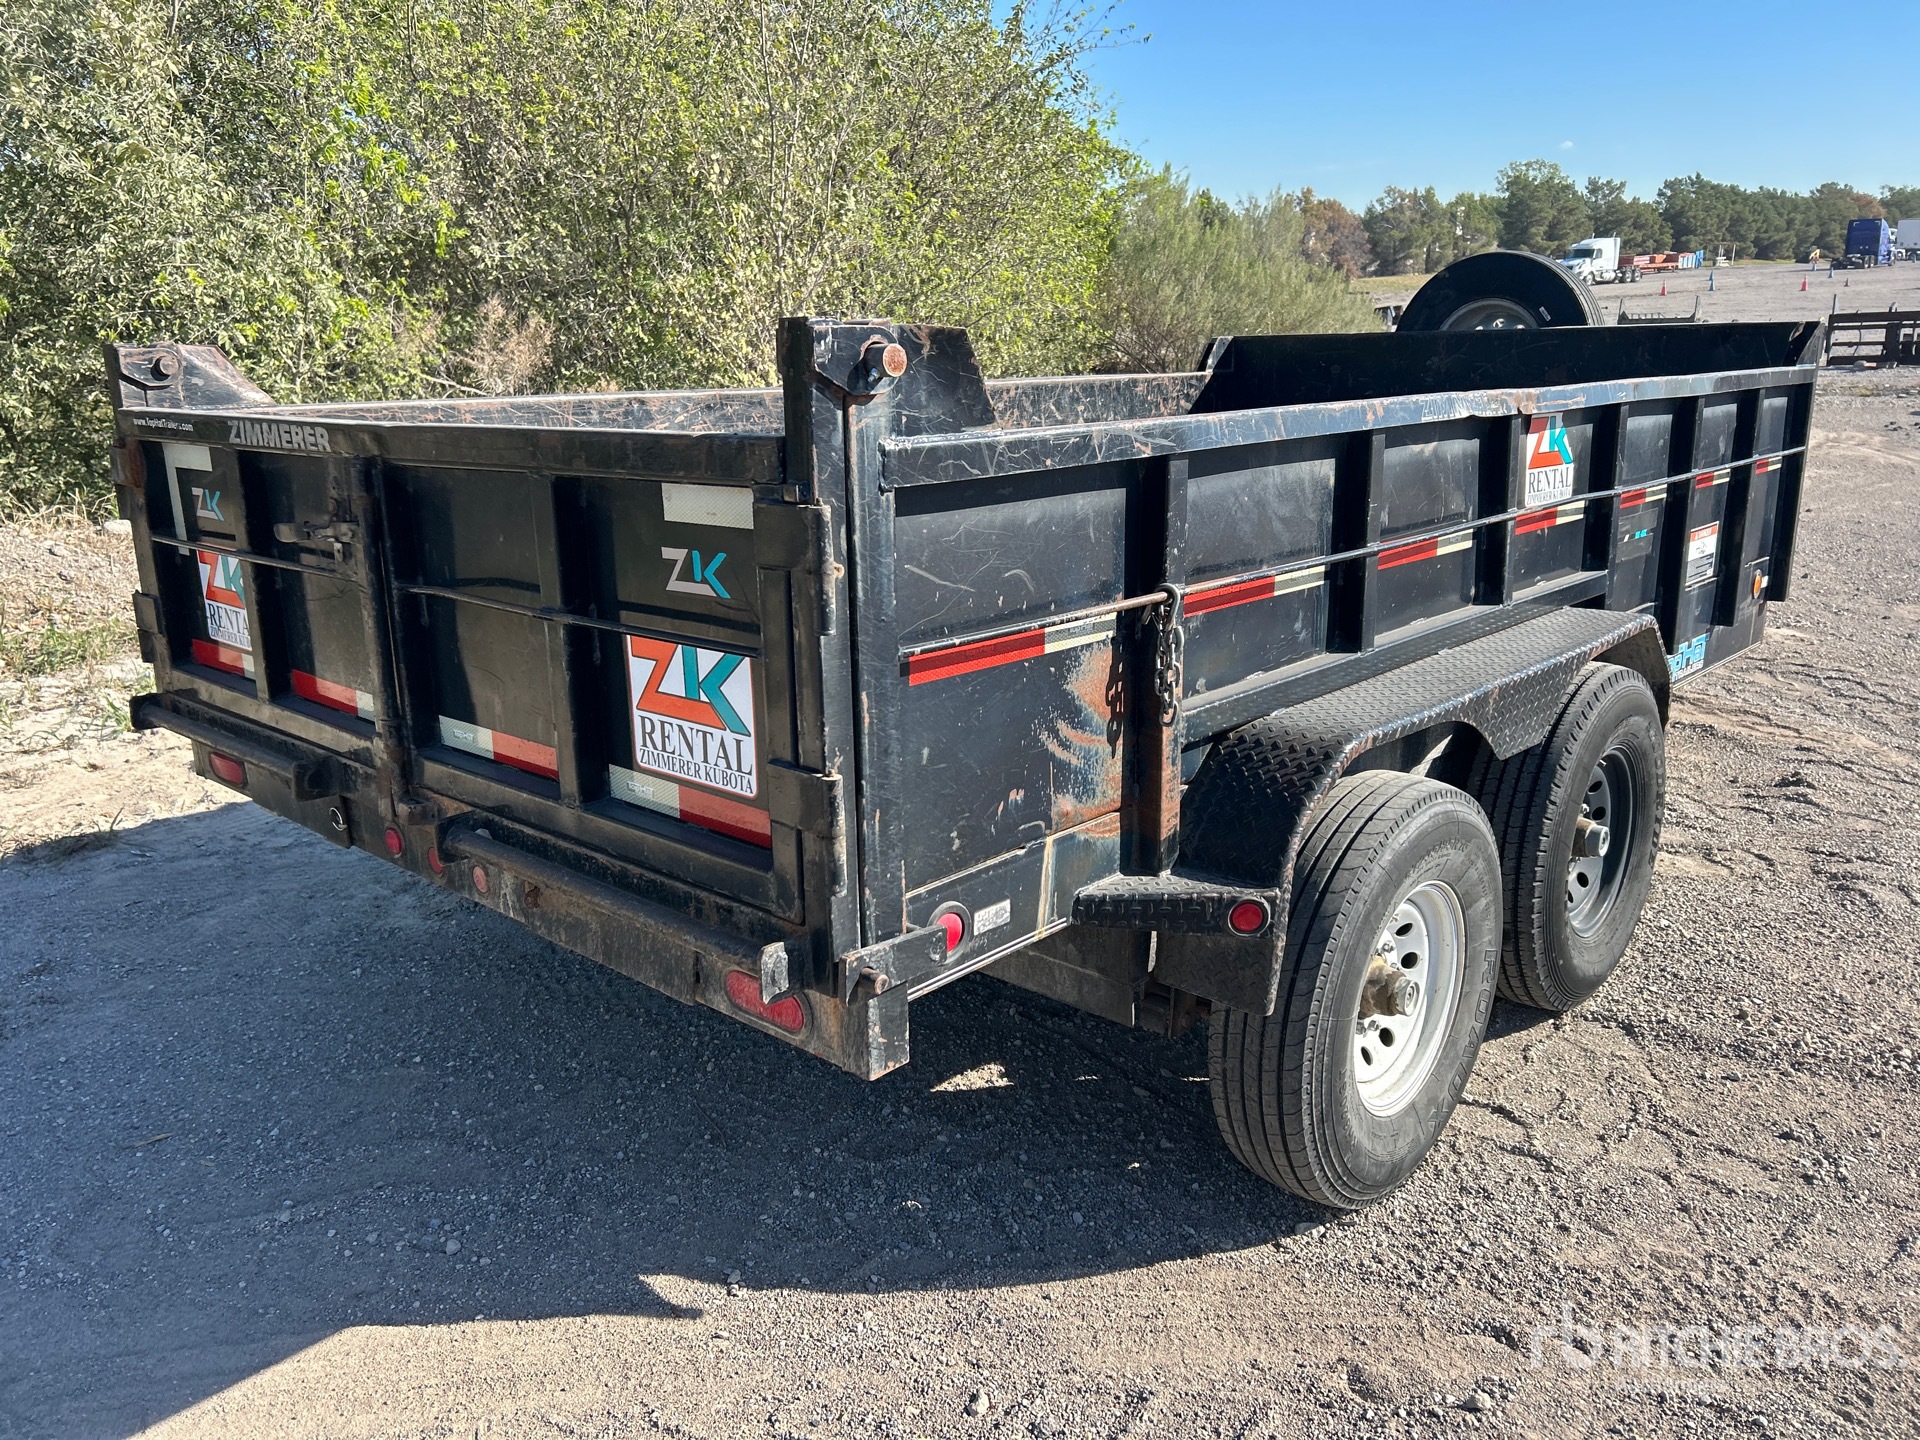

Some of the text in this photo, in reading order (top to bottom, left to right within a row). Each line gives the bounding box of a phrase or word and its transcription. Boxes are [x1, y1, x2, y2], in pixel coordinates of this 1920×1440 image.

[228, 420, 331, 452] ZIMMERER
[1528, 415, 1574, 470] ZK
[191, 487, 225, 521] ZK
[1528, 466, 1572, 494] RENTAL
[661, 546, 732, 599] ZK
[207, 603, 250, 636] RENTA
[630, 635, 752, 737] ZK
[639, 715, 753, 776] RENTAL
[639, 748, 754, 794] ZIMMERER KUBOTA
[1427, 949, 1498, 1139] ROADX
